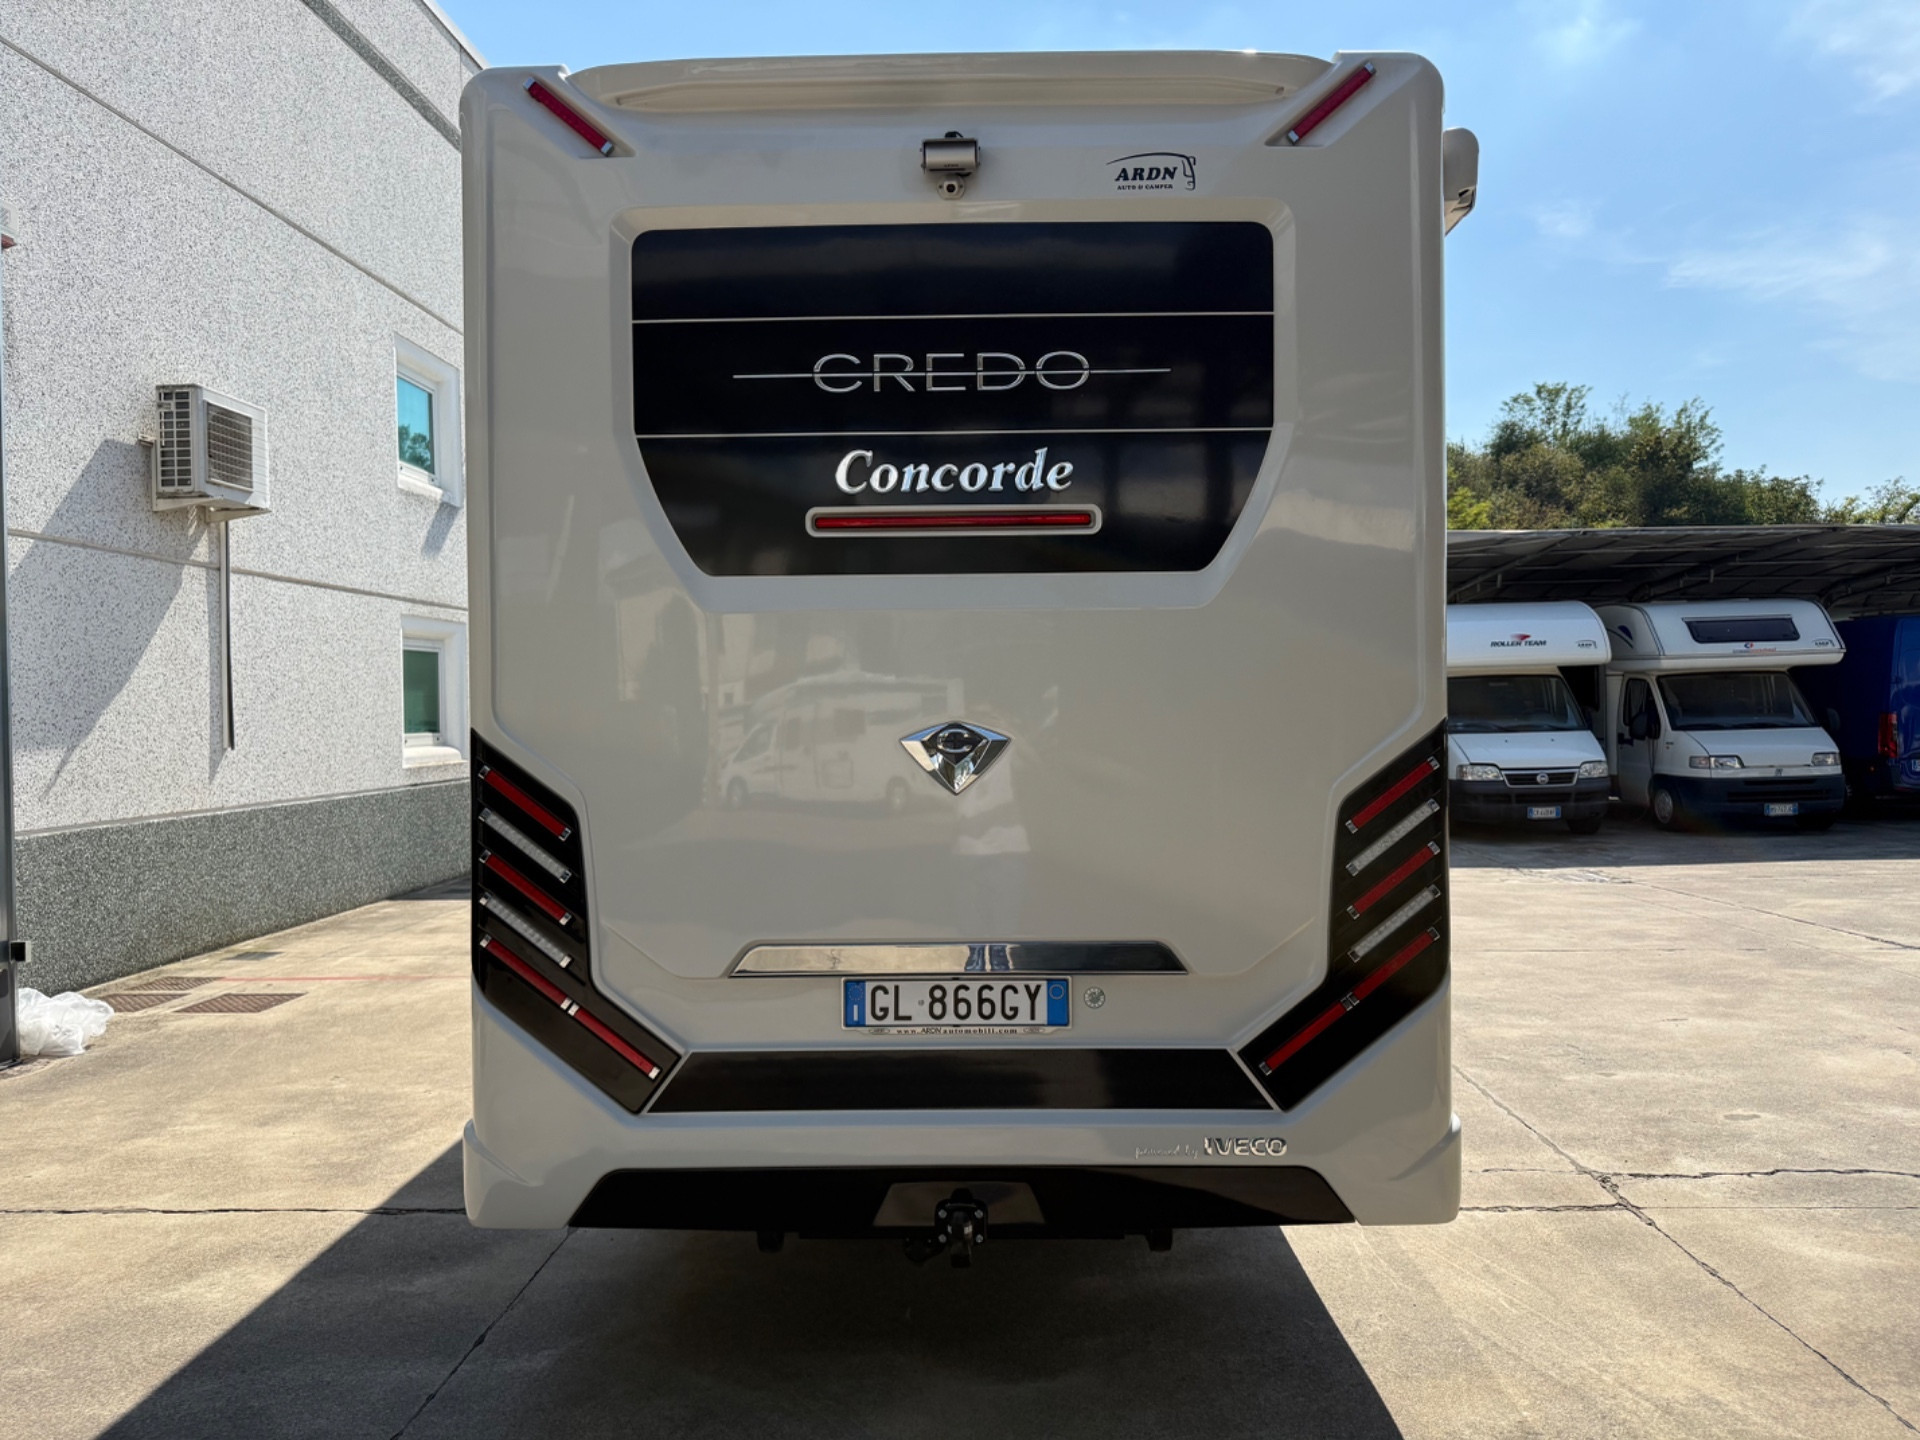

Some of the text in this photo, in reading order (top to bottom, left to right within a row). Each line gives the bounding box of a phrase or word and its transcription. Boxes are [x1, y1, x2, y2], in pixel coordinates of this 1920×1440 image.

[1115, 167, 1178, 181] ARDN
[813, 351, 1090, 393] CREDO
[834, 447, 1074, 494] Concorde
[1490, 640, 1521, 648] ROLLER
[870, 984, 912, 1021] GL
[928, 984, 1042, 1021] 866GY
[1204, 1137, 1288, 1157] IVECO
